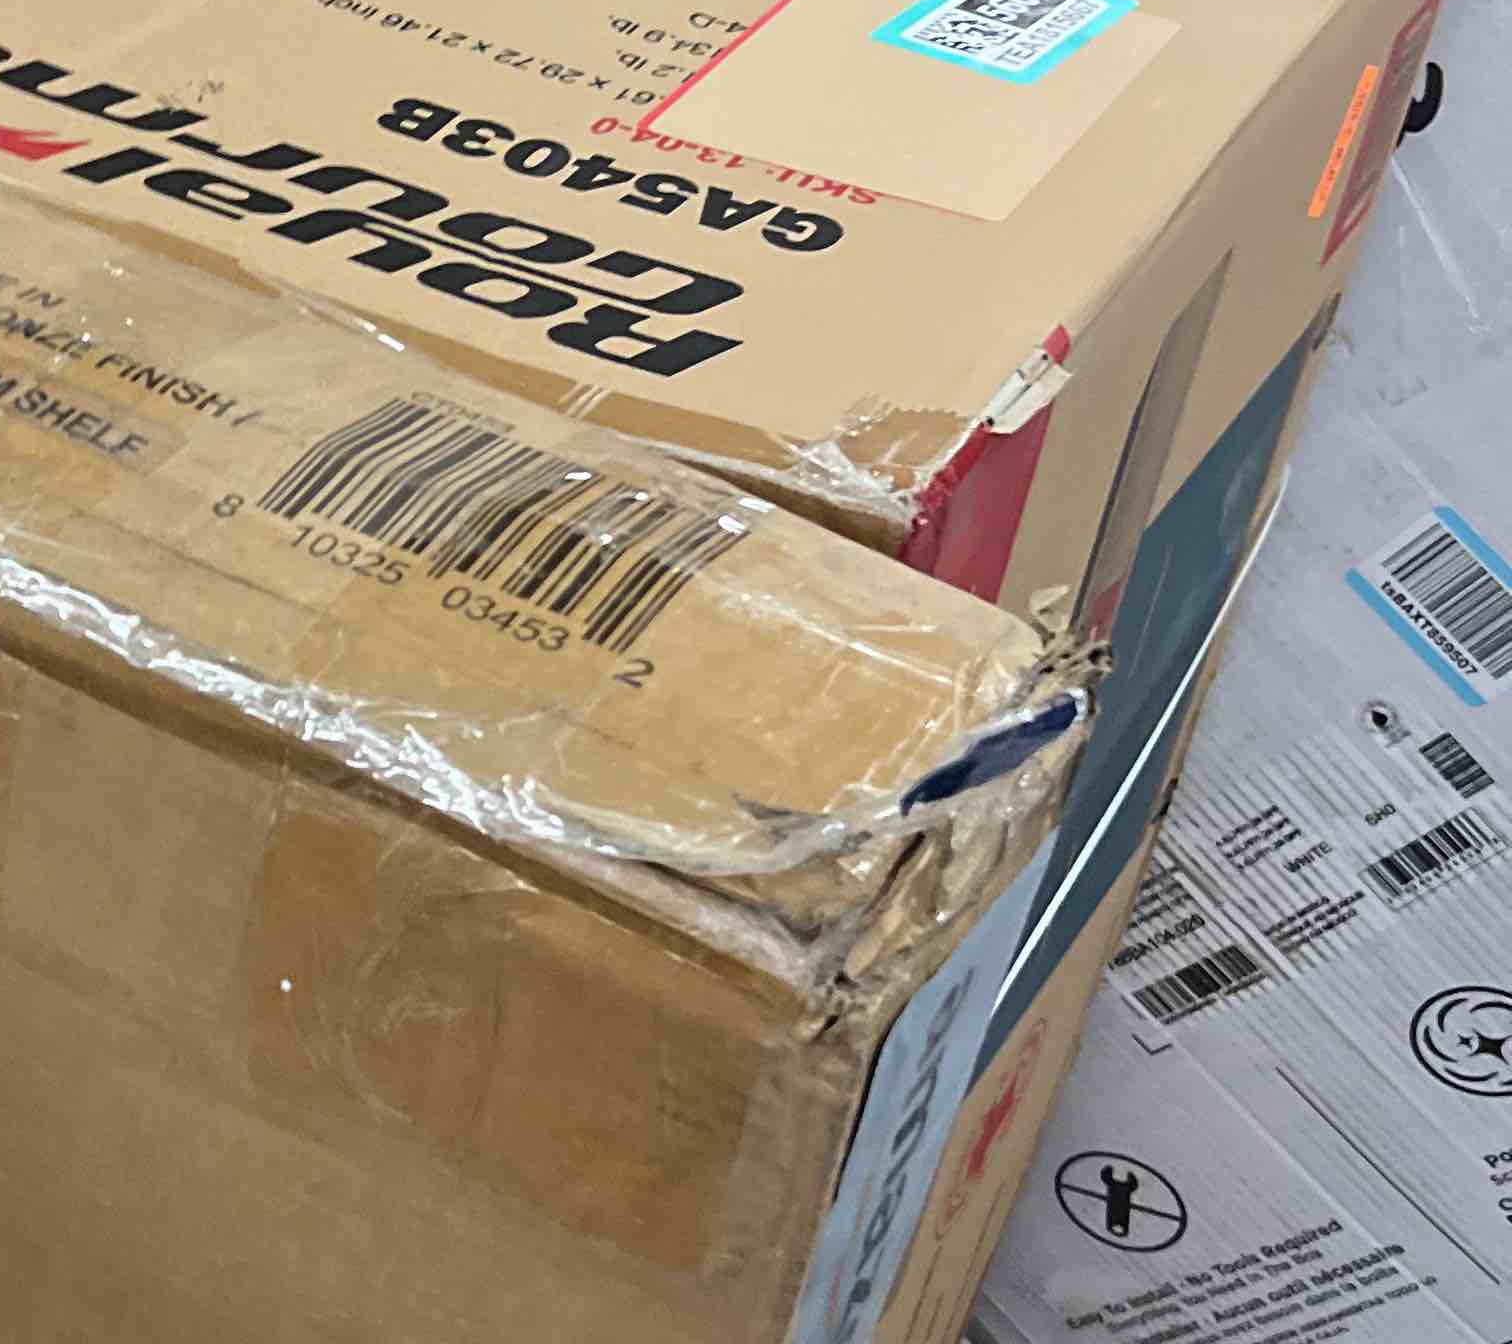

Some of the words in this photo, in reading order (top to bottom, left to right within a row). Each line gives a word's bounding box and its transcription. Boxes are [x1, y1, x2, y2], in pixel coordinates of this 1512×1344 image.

[380, 10, 465, 50] 21.46
[492, 45, 587, 87] 29.72
[376, 96, 845, 253] GA5403B
[19, 280, 67, 310] IN
[60, 145, 746, 378] Royal
[93, 352, 236, 420] FINISH
[12, 385, 153, 460] SHELF
[212, 493, 245, 518] 8
[290, 523, 412, 588] 10325
[439, 585, 570, 653] 03453
[613, 658, 656, 690] 2
[1209, 1250, 1263, 1278] Tools
[1257, 1219, 1346, 1260] Required
